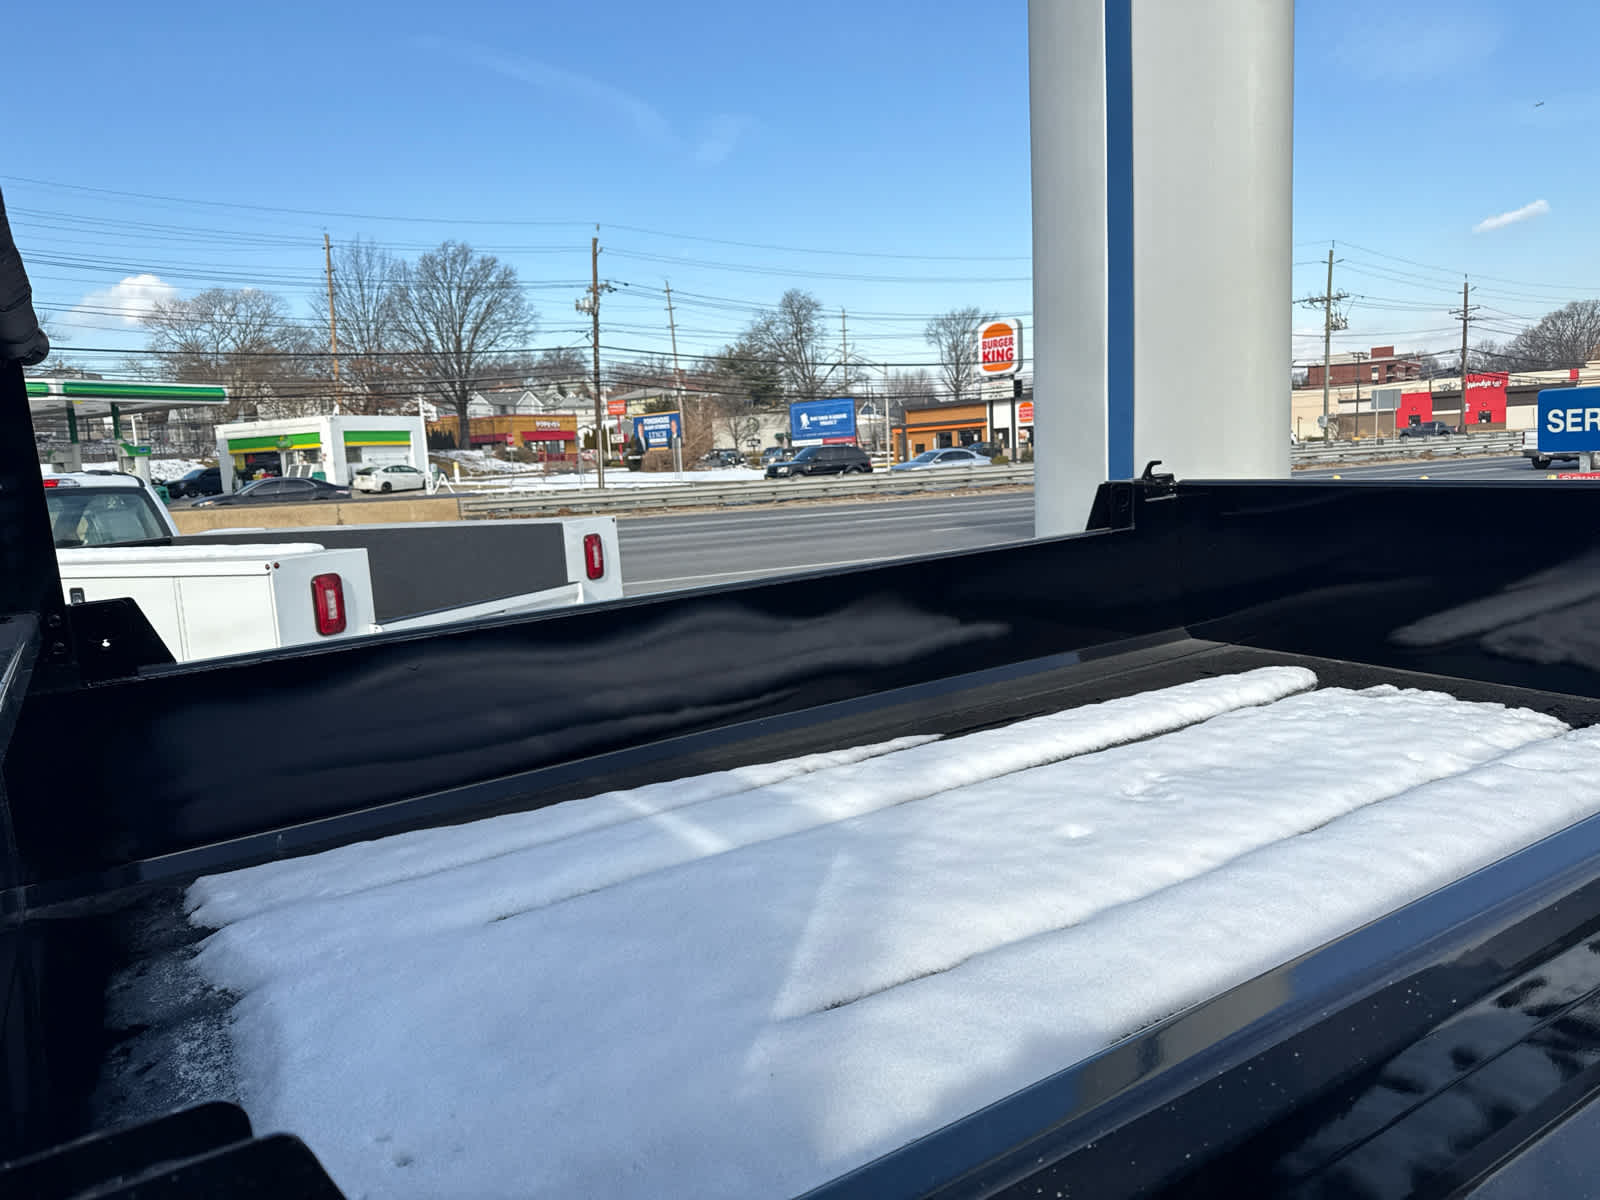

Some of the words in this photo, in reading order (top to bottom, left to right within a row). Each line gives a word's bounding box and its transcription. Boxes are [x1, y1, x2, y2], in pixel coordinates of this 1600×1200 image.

[982, 337, 1014, 350] BURGER
[982, 347, 1014, 363] KING
[1546, 407, 1600, 433] SER
